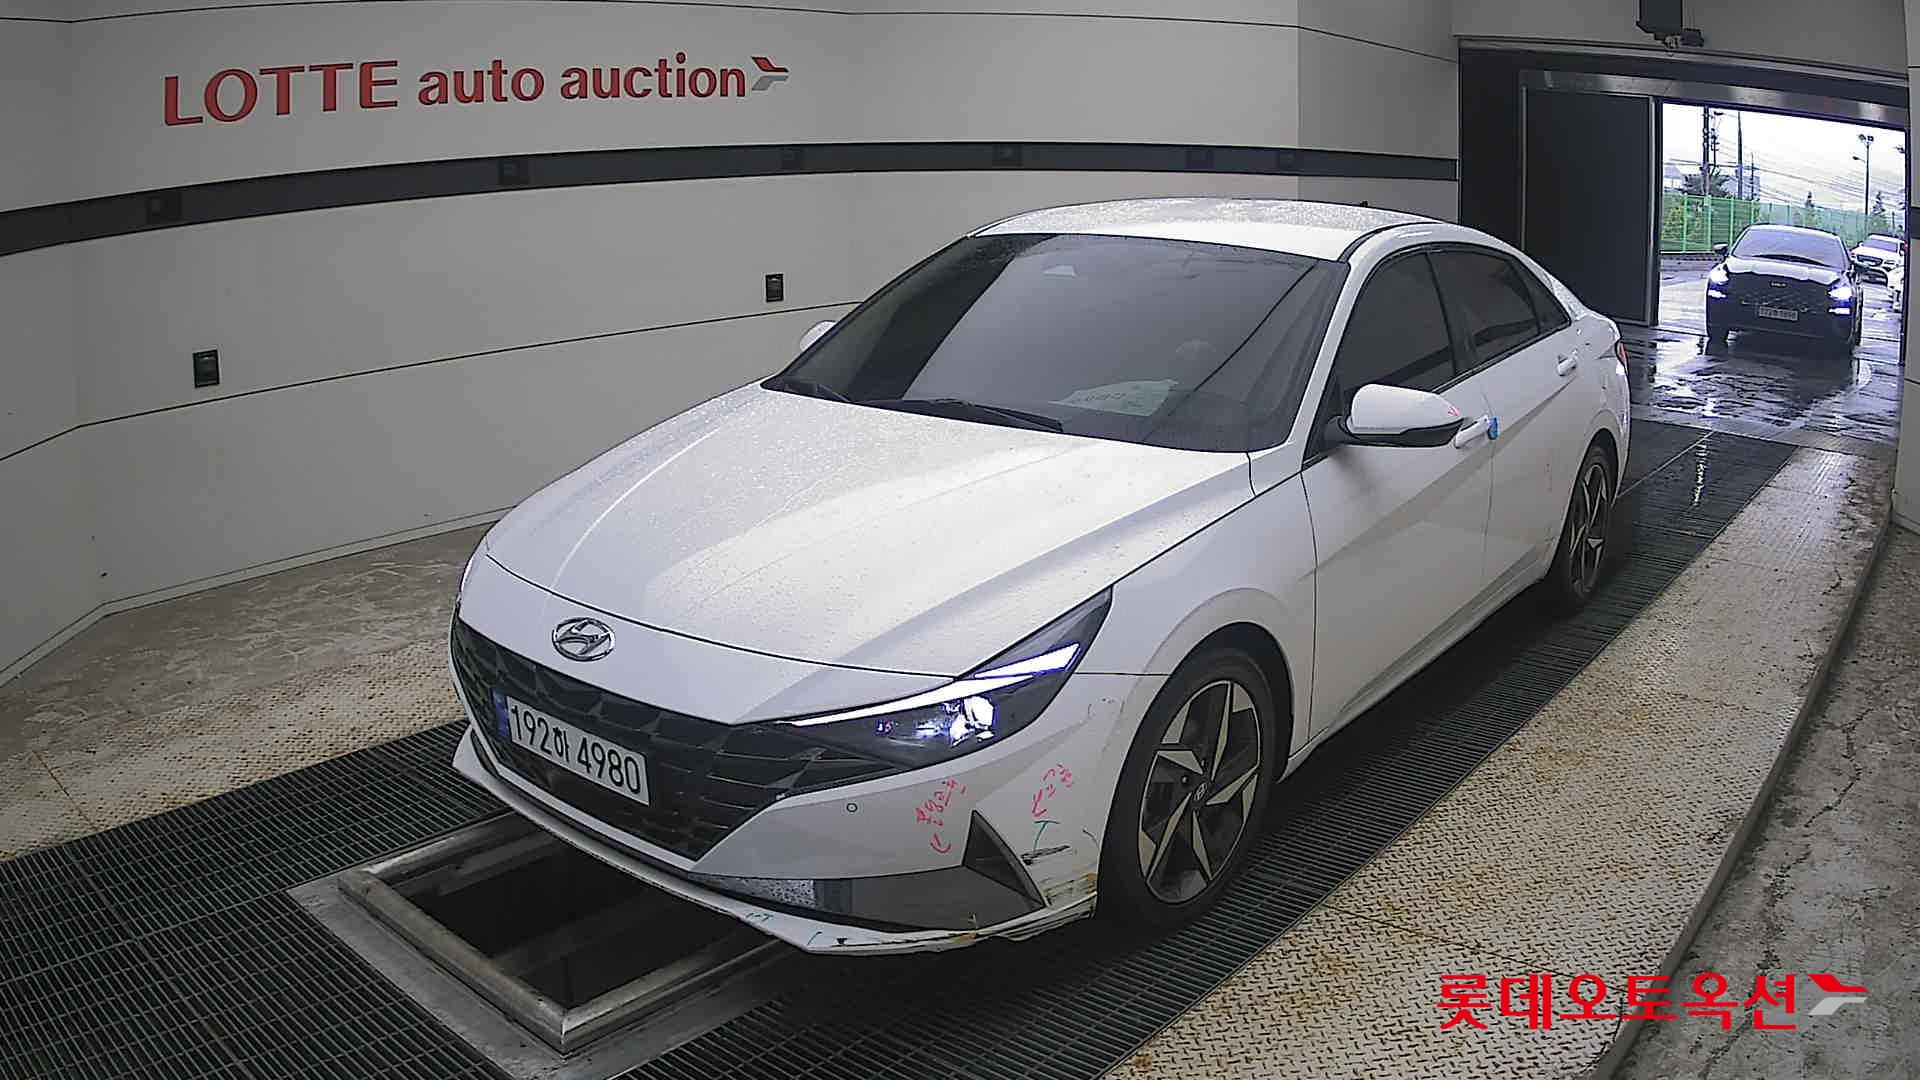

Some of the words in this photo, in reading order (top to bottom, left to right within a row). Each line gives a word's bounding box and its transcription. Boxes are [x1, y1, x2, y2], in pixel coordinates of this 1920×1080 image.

[164, 59, 399, 127] LOTTE
[417, 57, 545, 106] auto
[560, 52, 747, 100] auction
[511, 704, 570, 763] 192하
[577, 736, 641, 794] 4980
